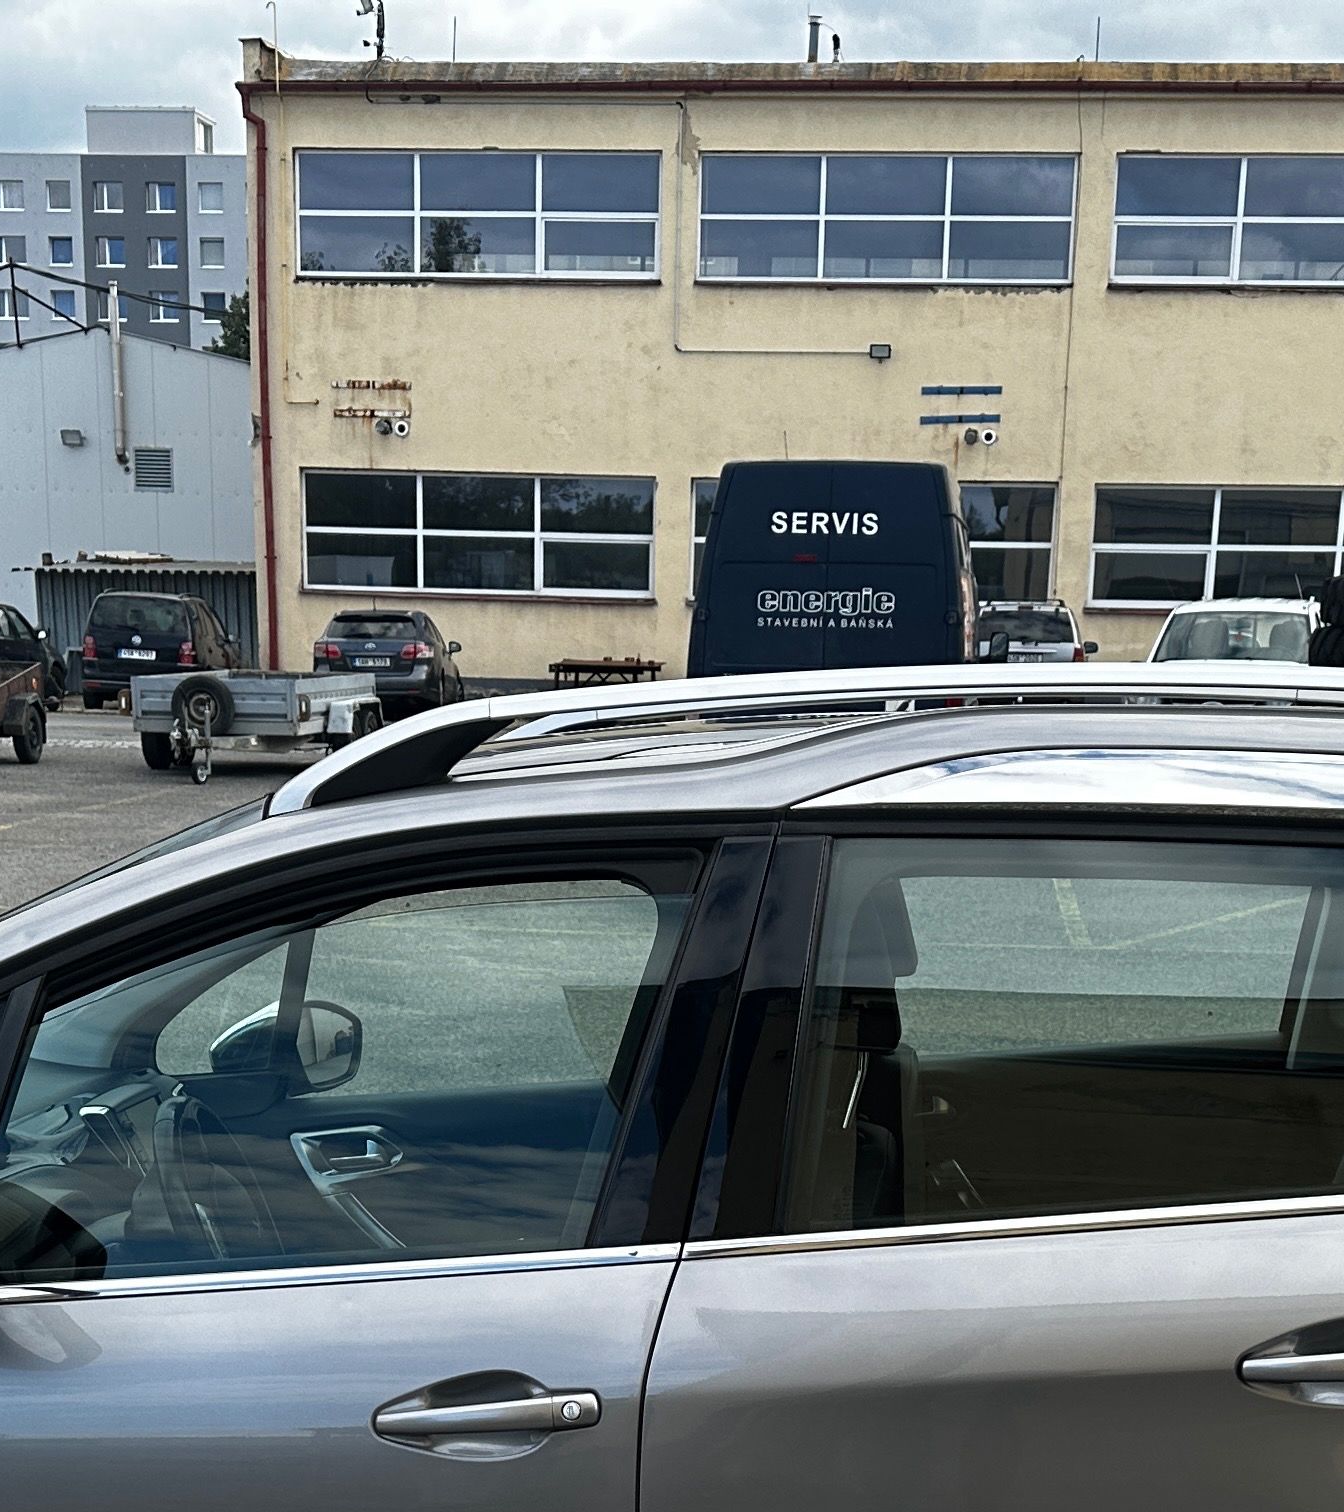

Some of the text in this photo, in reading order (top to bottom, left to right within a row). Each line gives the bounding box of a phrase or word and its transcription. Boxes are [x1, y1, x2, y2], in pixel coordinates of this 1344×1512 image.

[770, 511, 880, 536] SERVIS
[757, 587, 896, 616] energie
[757, 616, 894, 629] STAVEBNÍ A BÁŇSKÁ
